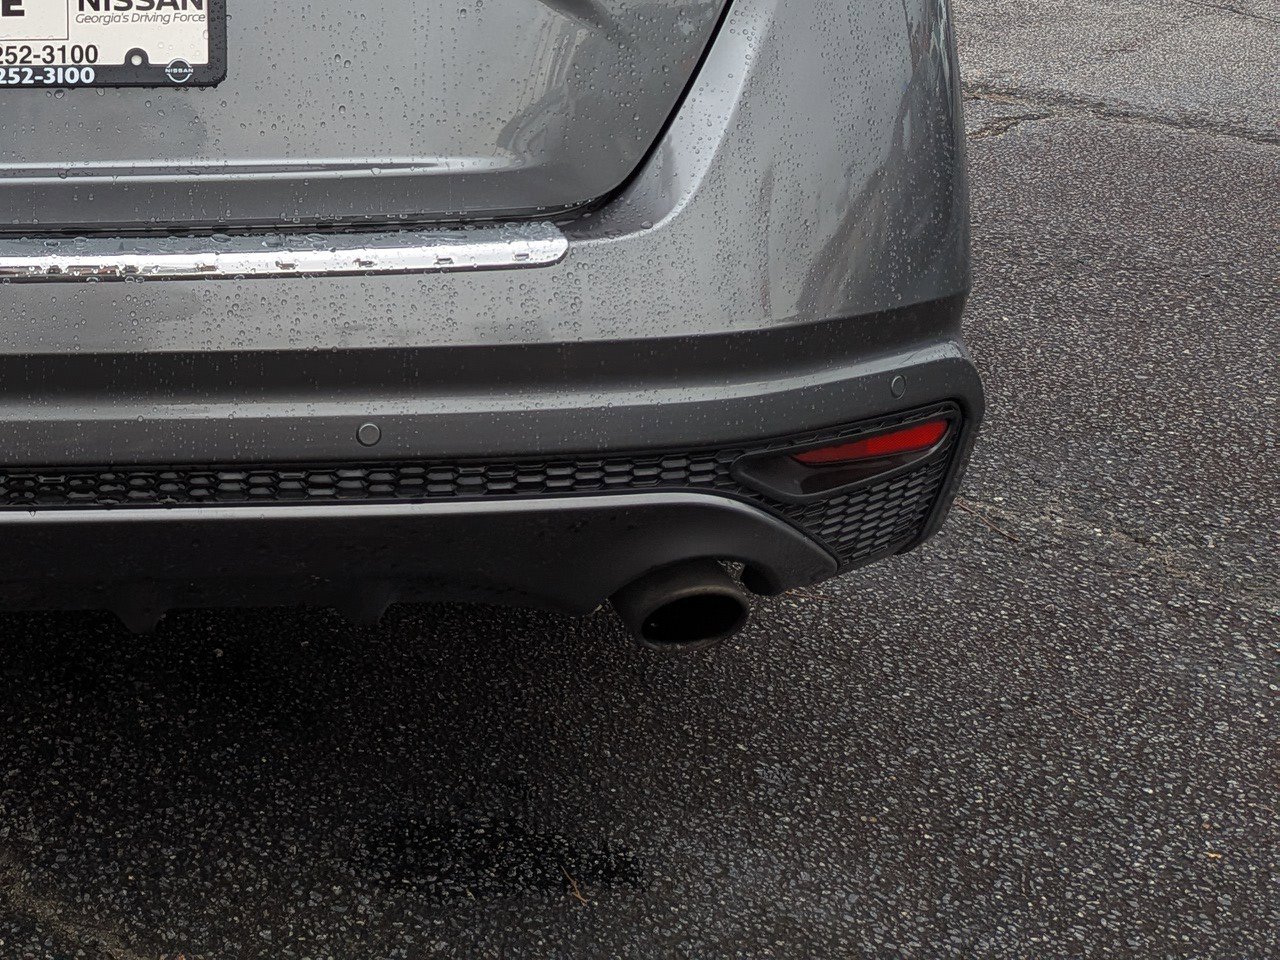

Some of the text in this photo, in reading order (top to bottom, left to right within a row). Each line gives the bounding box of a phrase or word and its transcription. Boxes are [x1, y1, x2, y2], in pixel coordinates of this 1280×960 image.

[75, 12, 206, 25] Georgia's Driving Force
